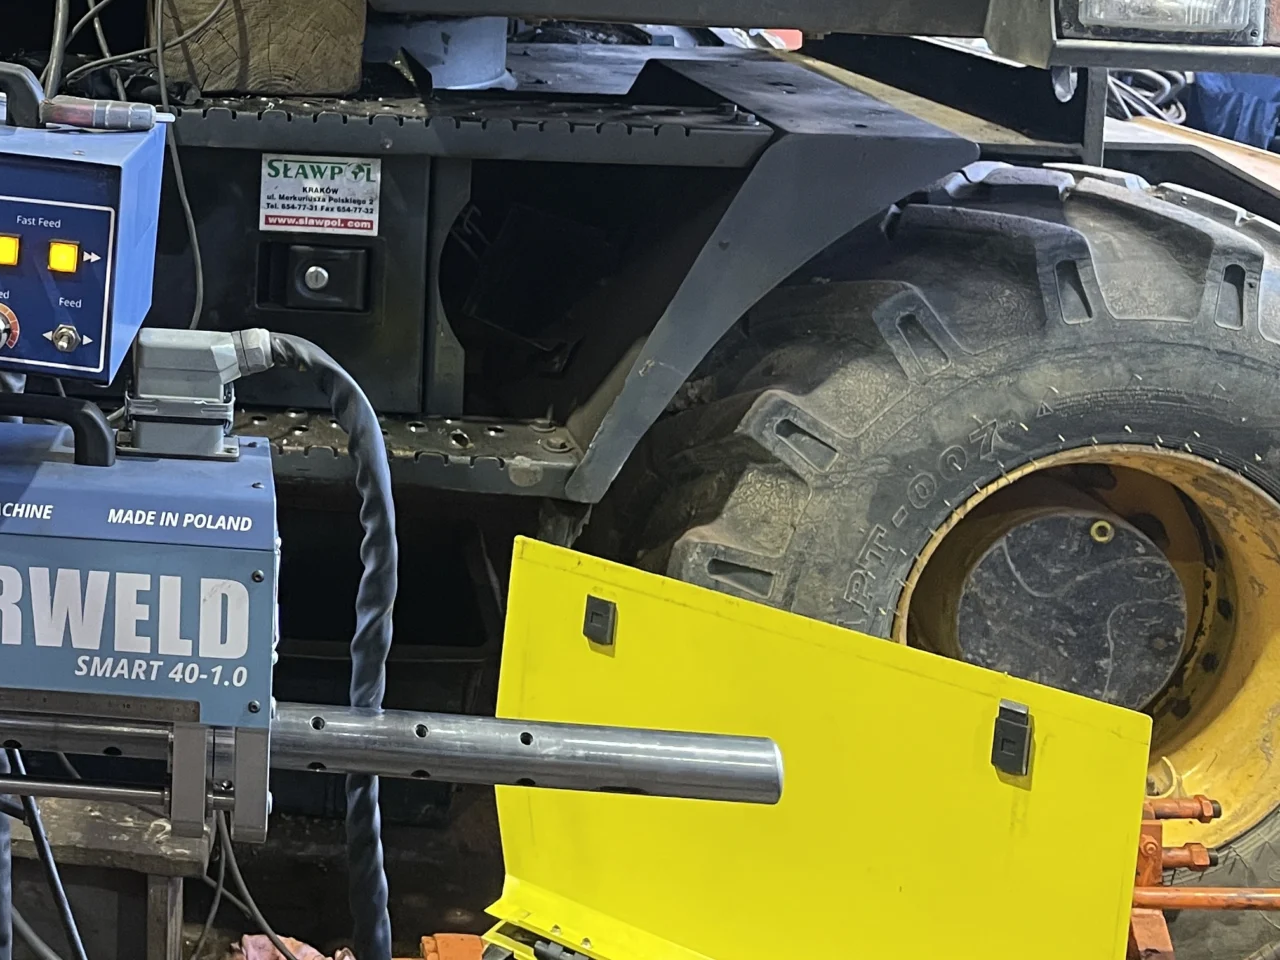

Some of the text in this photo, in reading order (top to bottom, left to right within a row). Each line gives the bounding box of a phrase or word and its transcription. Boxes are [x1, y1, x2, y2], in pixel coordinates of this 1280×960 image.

[302, 186, 339, 195] KRAKÓW
[16, 215, 62, 228] Fast Feed
[58, 297, 82, 308] Feed
[107, 508, 157, 527] MADE
[159, 510, 180, 527] IN
[183, 512, 253, 532] POLAND
[74, 655, 248, 688] SMART 40-1.0
